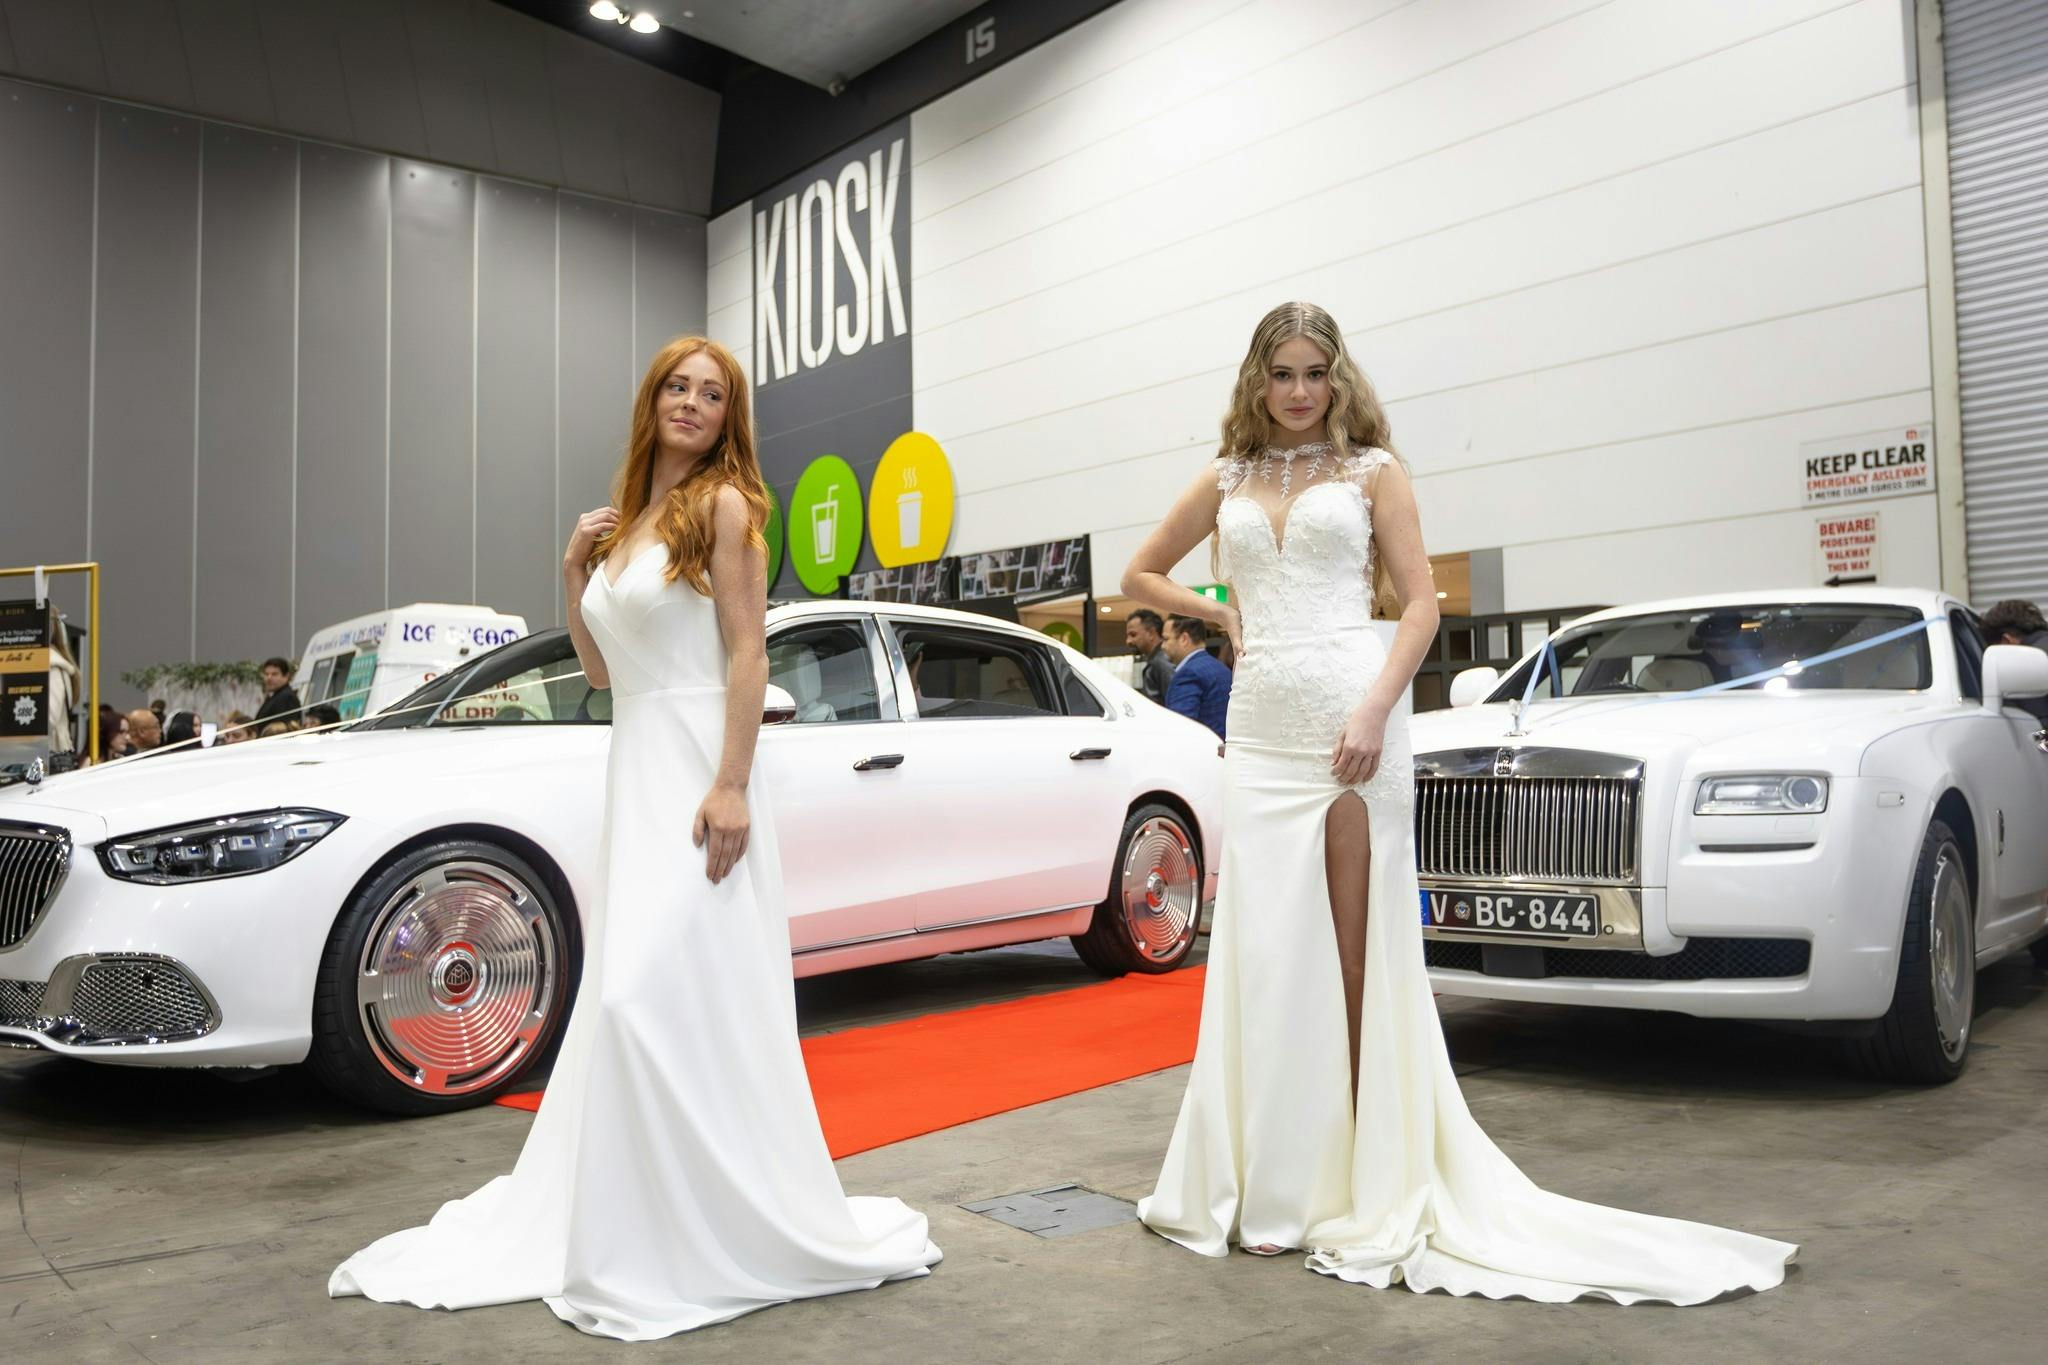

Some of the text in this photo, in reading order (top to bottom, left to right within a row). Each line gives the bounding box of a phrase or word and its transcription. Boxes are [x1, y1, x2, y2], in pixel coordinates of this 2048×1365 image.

[965, 16, 996, 64] 15
[755, 138, 908, 387] KIOSK
[1806, 443, 1926, 478] KEEP CLEAR
[1807, 464, 1928, 491] EMERGENCY AISLEWAY
[1819, 517, 1876, 537] BEWARE!
[1820, 534, 1876, 549] PEDESTRIAN
[1826, 547, 1871, 561] WALKWAY
[1828, 560, 1871, 573] THIS WAY
[1429, 893, 1448, 924] V
